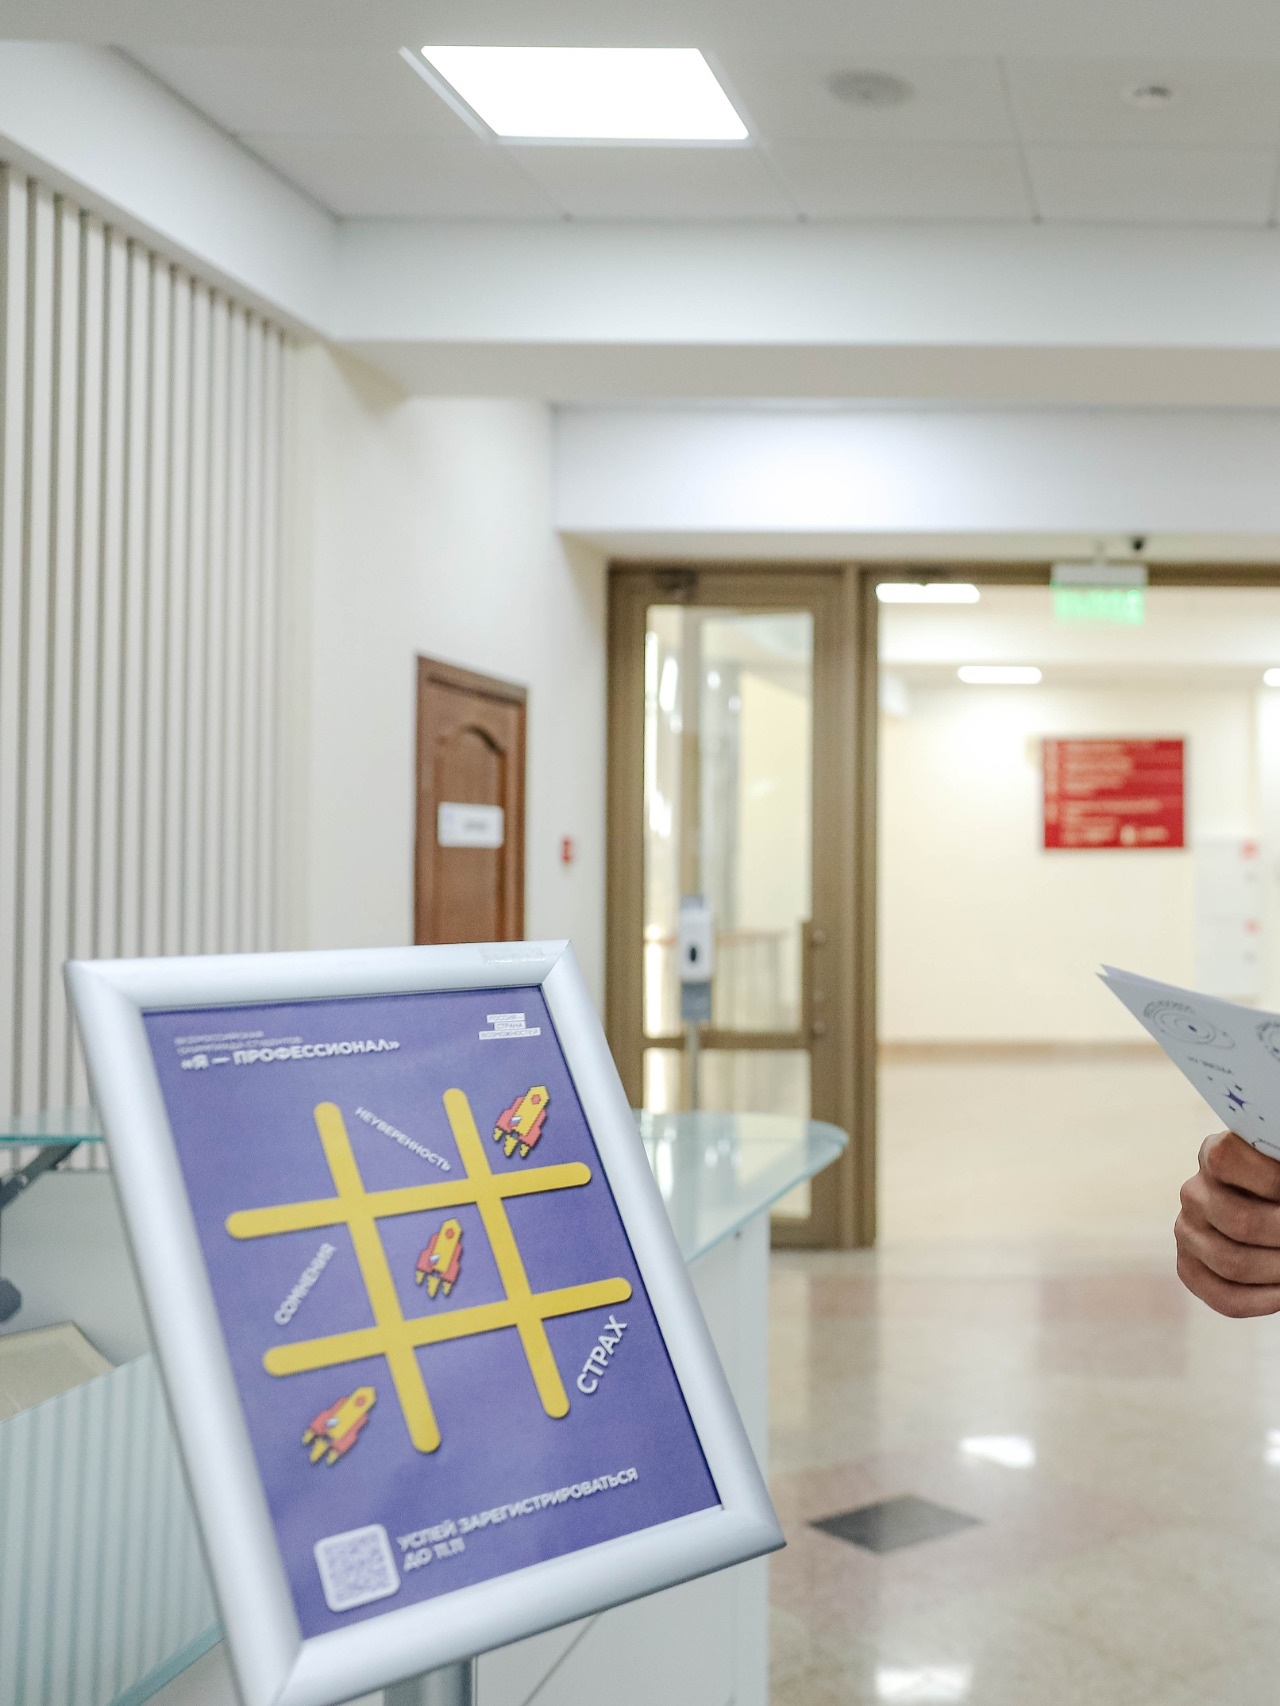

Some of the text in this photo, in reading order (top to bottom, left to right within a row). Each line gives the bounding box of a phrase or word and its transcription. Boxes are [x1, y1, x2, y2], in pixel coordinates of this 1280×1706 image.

[232, 1038, 401, 1066] ПРОФЕССИОНАЛ»
[354, 1106, 452, 1173] НЕУВЕРЕННОСТЬ
[273, 1242, 338, 1326] СОМНЕНИЯ
[576, 1315, 629, 1396] СТРАХ
[396, 1466, 640, 1552] УСПЕЙ ЗАРЕГИСТРИРОВАТЬСЯ
[403, 1547, 433, 1572] ДО
